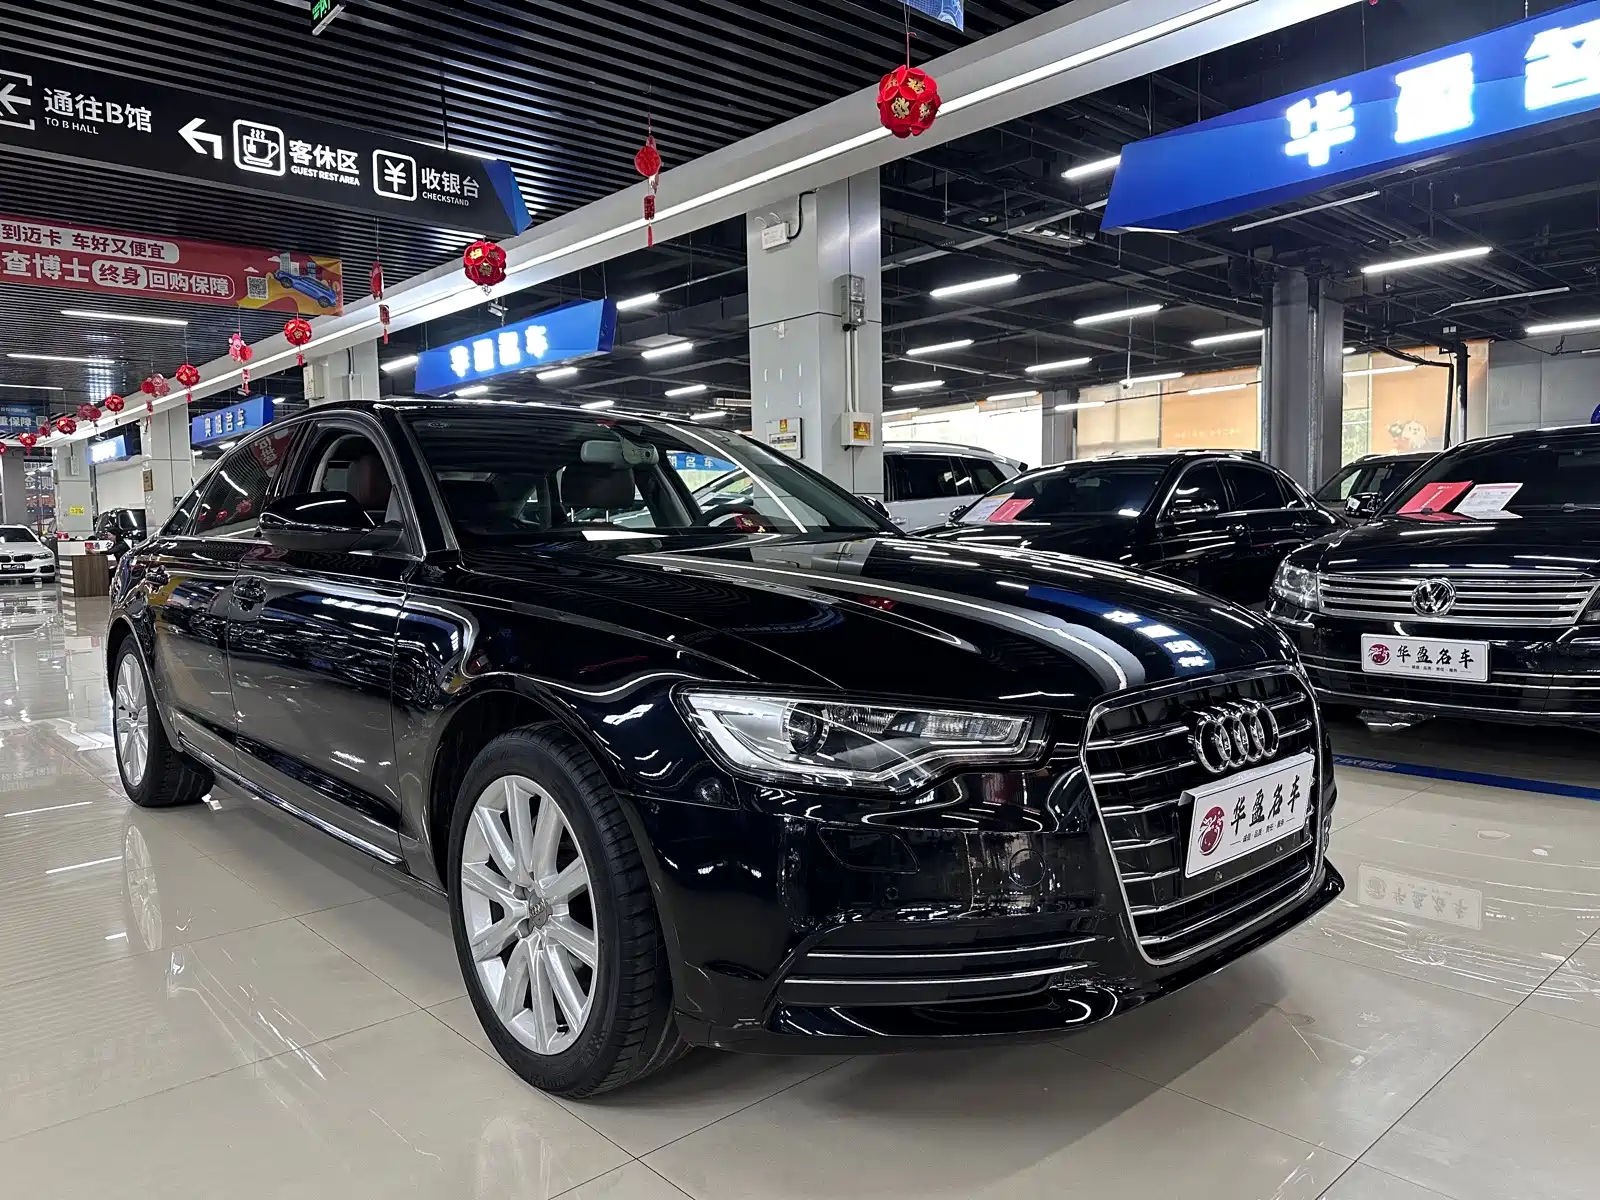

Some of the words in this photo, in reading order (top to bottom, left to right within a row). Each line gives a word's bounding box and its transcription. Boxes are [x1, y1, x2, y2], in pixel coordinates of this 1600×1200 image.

[43, 87, 152, 133] 通往B馆
[44, 116, 59, 128] TO
[62, 120, 70, 129] B
[72, 121, 99, 135] HALL
[288, 140, 360, 175] 客休区
[290, 165, 319, 179] GUEST
[319, 170, 340, 183] REST
[339, 175, 361, 187] AREA
[421, 167, 480, 199] 收银台
[422, 191, 470, 207] CHECKSTAND
[1, 223, 62, 246] 到迈卡
[72, 232, 165, 260] 车好又便宜
[1, 250, 90, 283] 查博士
[98, 263, 141, 287] 终身
[148, 269, 230, 297] 回购保障
[1396, 644, 1475, 669] 华盈名车
[1230, 774, 1301, 836] 华盈名车
